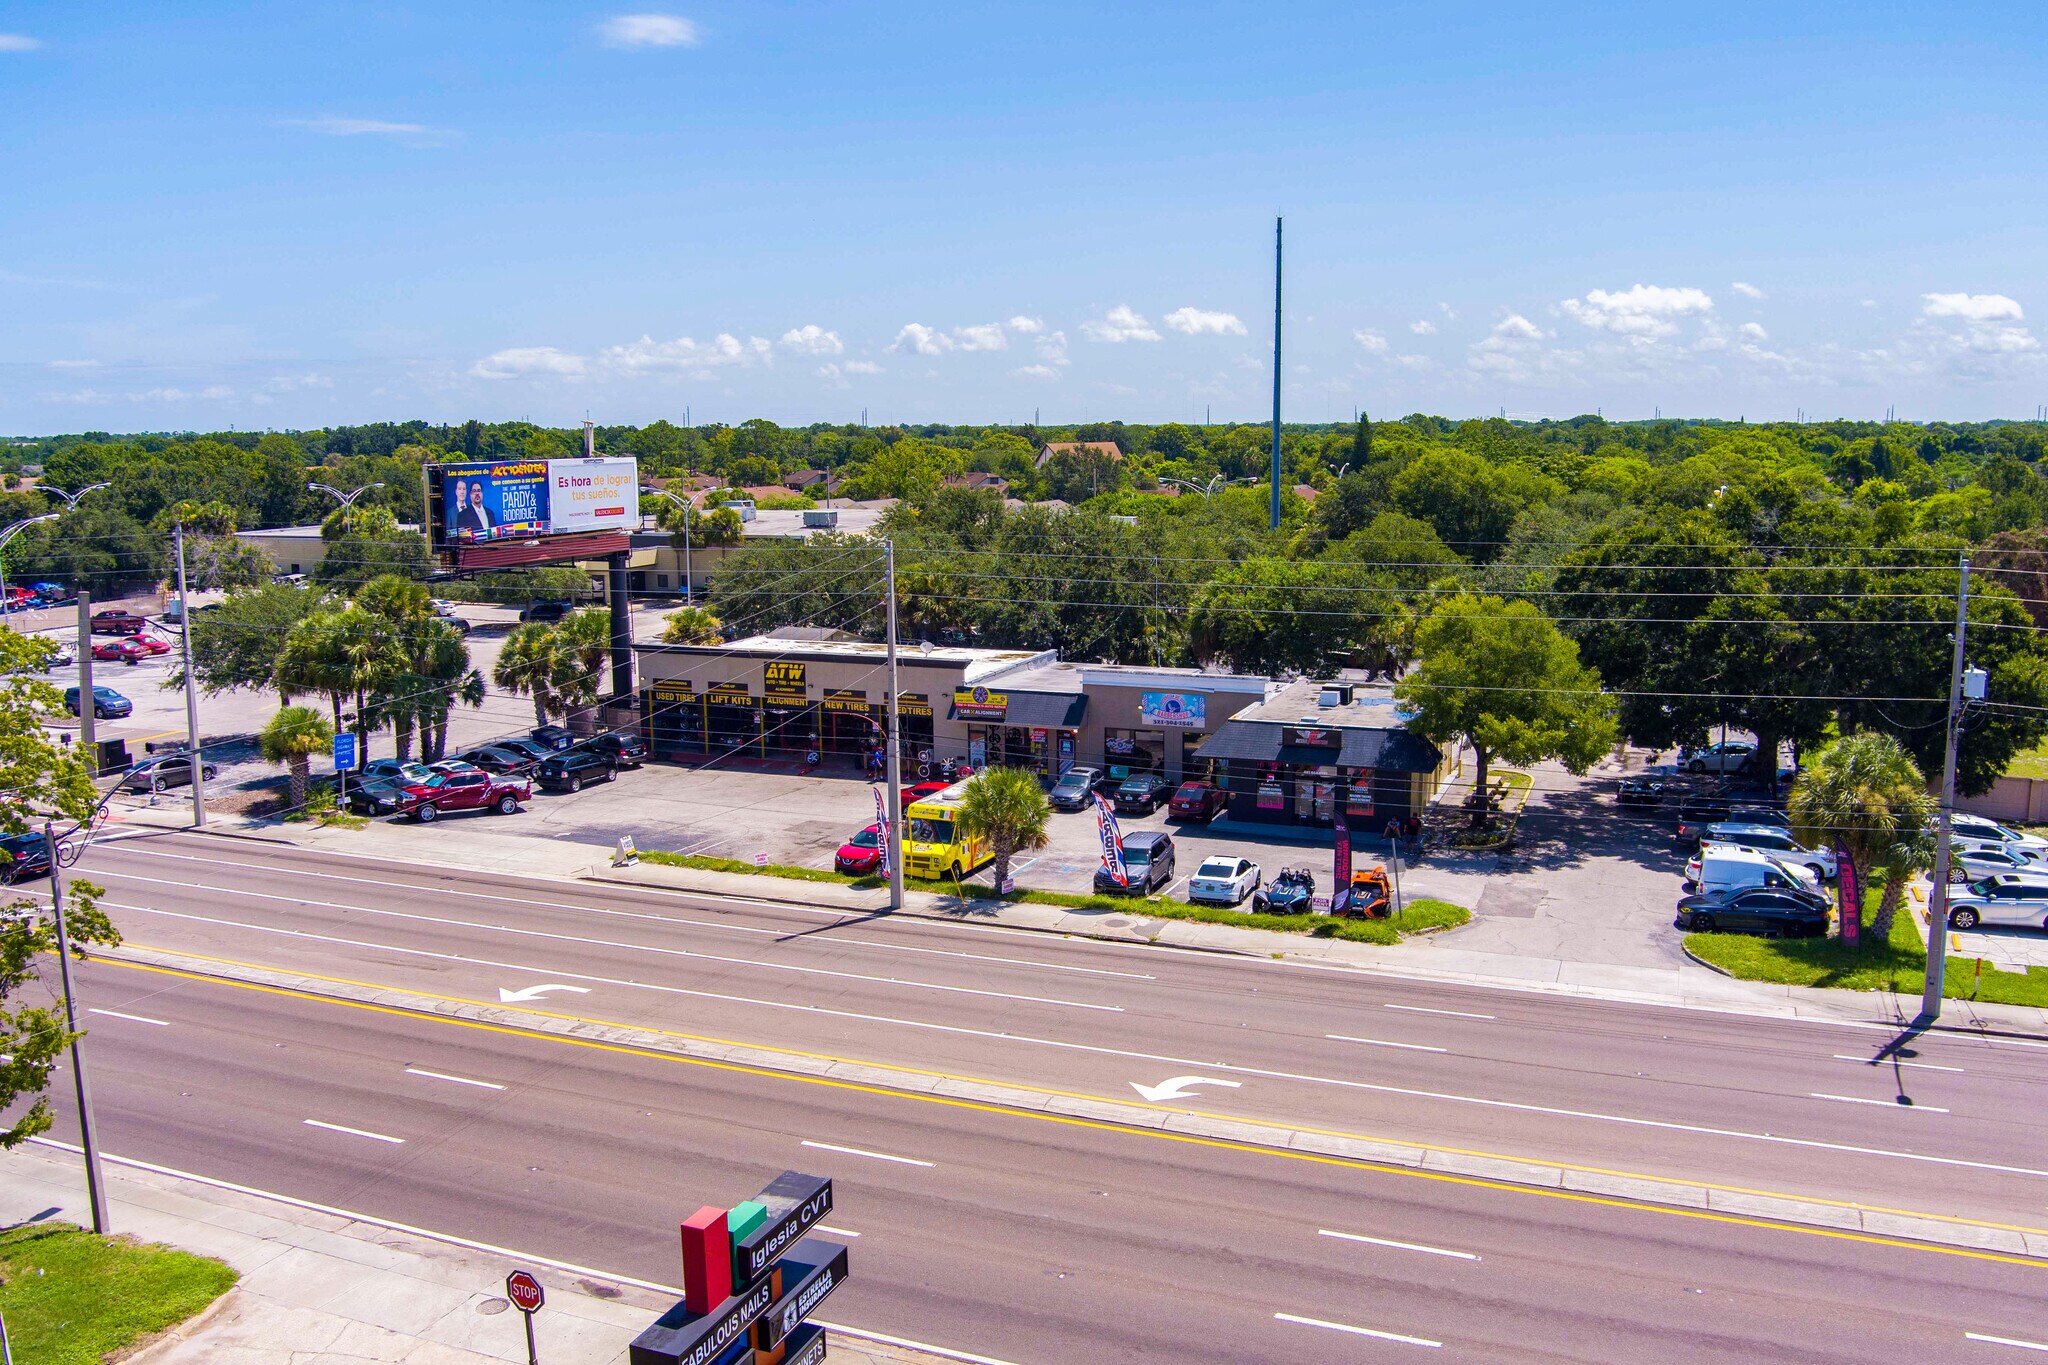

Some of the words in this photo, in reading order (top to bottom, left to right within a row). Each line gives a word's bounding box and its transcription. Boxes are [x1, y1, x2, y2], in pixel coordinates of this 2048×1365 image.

[447, 469, 457, 477] Los
[457, 469, 482, 477] abogados
[491, 463, 546, 477] ACCIDENTES
[558, 476, 569, 488] Es
[571, 475, 591, 487] hora
[593, 474, 605, 486] de
[606, 474, 632, 487] lograr
[502, 490, 530, 509] PARDY
[571, 490, 586, 501] tus
[503, 507, 537, 522] RODRIGUEZ
[765, 663, 805, 680] ATW
[656, 691, 675, 701] USED
[675, 692, 696, 703] TIRES
[710, 695, 729, 704] LIFT
[731, 695, 752, 706] KITS
[766, 697, 809, 707] ALIGNMENT
[824, 701, 844, 710] NEW
[845, 702, 870, 712] TIRES
[886, 705, 907, 714] UED
[908, 706, 932, 716] TIRES
[1840, 863, 1857, 938] DECALS
[751, 1220, 798, 1269] Iglesia
[800, 1188, 829, 1224] CVT
[512, 1283, 538, 1300] STOP
[798, 1268, 832, 1307] ESTRELLA
[740, 1285, 769, 1324] NAILS
[799, 1279, 833, 1317] INSURANCE
